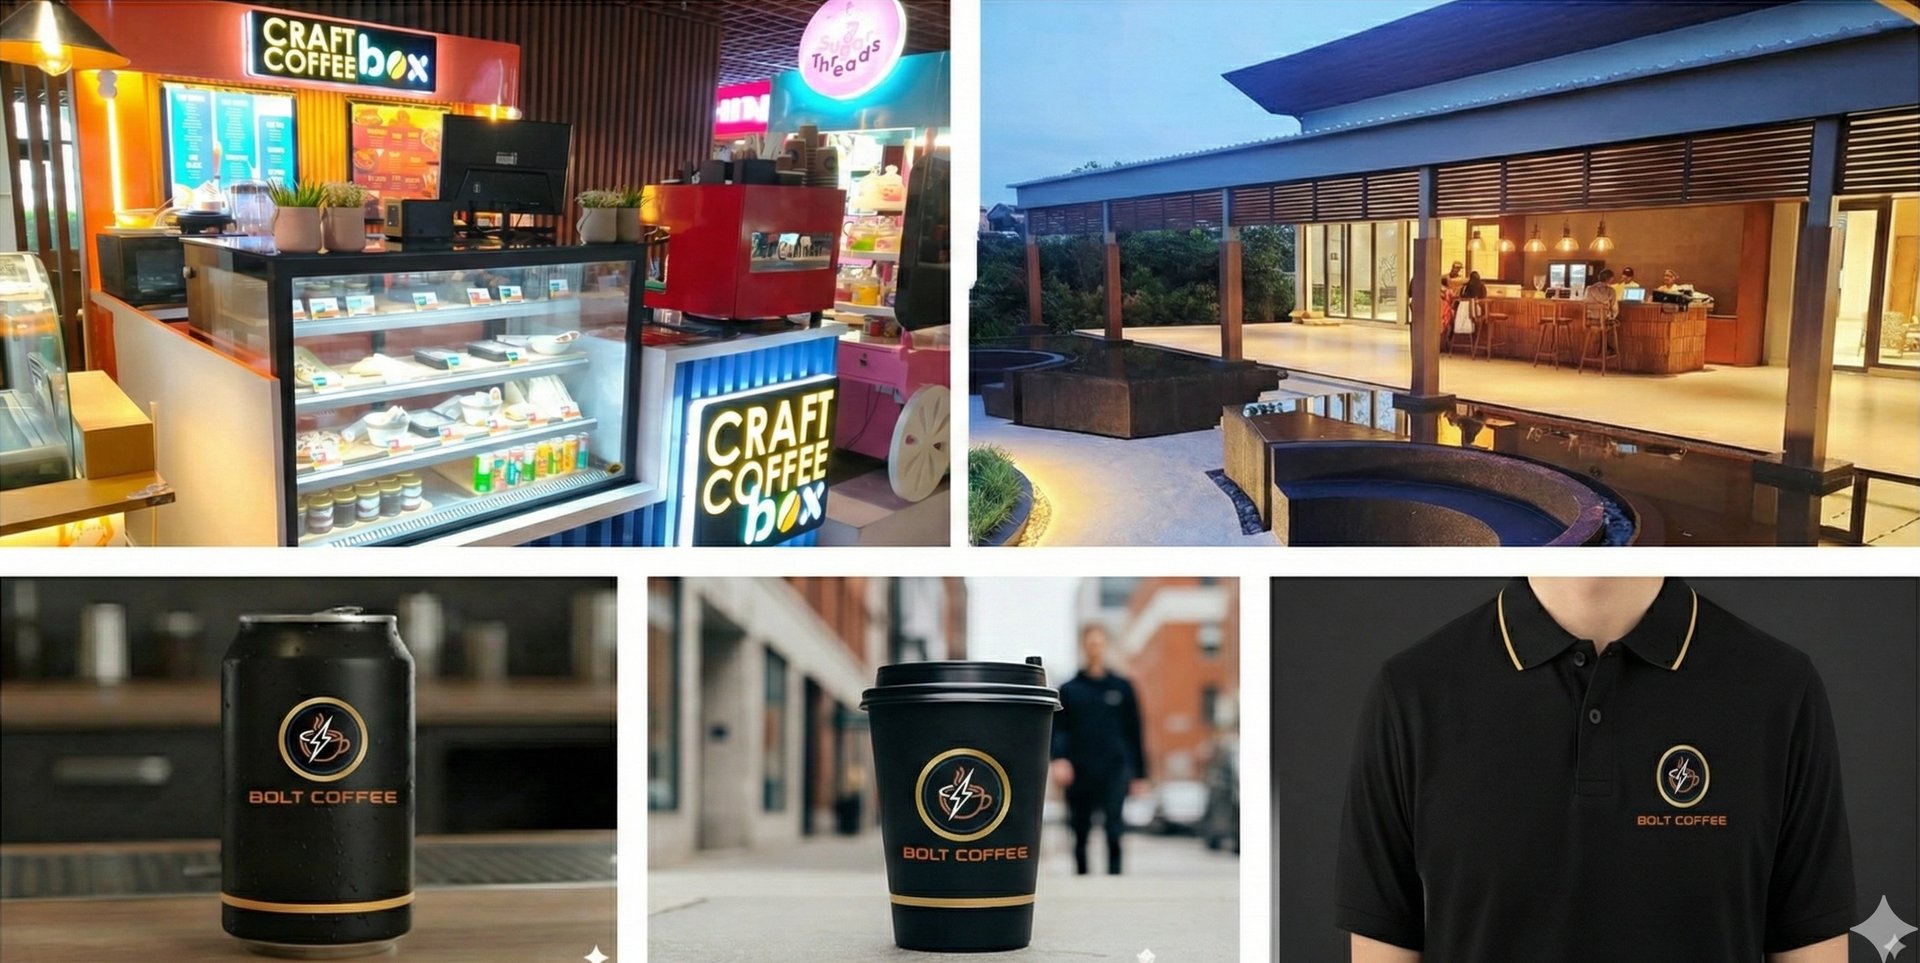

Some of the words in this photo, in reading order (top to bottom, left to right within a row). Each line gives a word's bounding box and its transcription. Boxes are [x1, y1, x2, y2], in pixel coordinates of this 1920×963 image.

[263, 17, 356, 55] CRAFT
[264, 46, 356, 79] COFFEE
[358, 33, 428, 83] box
[812, 39, 881, 77] Threads
[707, 389, 834, 467] CRAFT
[703, 439, 829, 515] COFFEE
[744, 481, 825, 545] box
[249, 790, 304, 804] BOLT
[310, 790, 398, 804] COFFEE
[1637, 815, 1672, 826] BOLT
[1675, 815, 1727, 826] COFFEE
[903, 846, 949, 861] BOLT
[955, 846, 1028, 862] COFFEE
